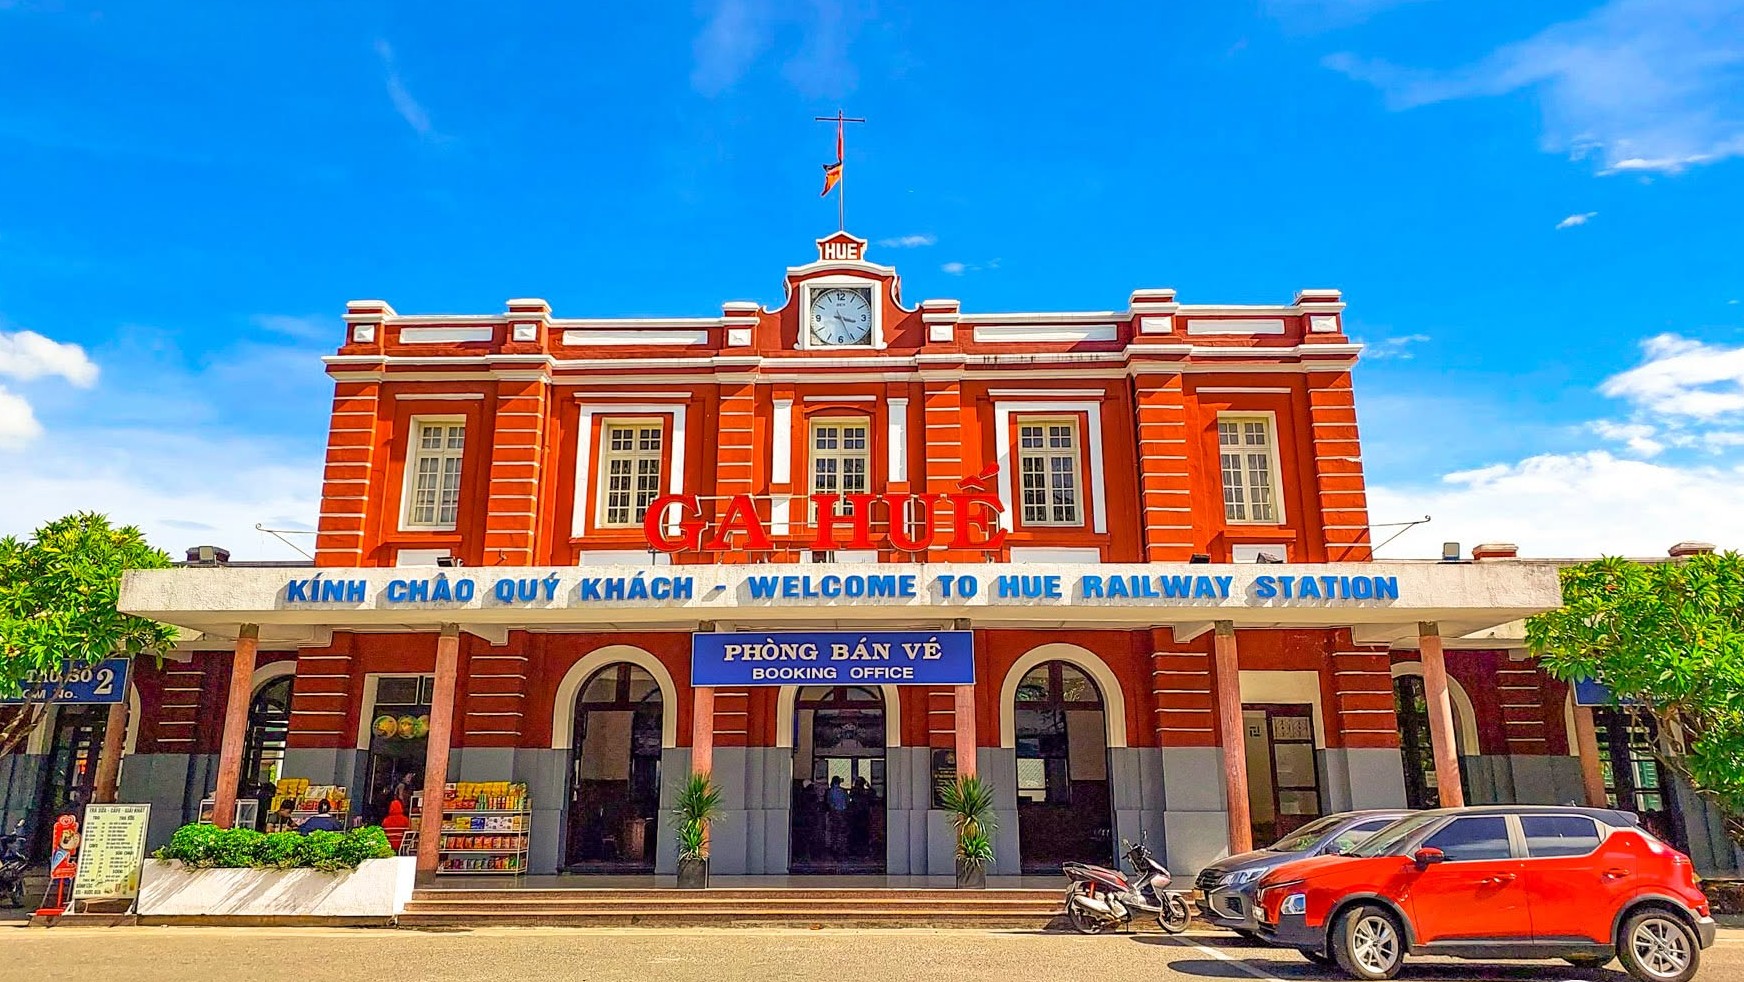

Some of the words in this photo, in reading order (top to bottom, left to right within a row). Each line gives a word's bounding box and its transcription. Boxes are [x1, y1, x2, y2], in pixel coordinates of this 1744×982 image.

[824, 242, 858, 260] HUE
[836, 292, 846, 301] 12
[815, 314, 822, 322] 9
[860, 315, 867, 323] 3
[837, 335, 845, 344] 6
[644, 494, 774, 551] GA
[810, 462, 1006, 550] HUẾ
[286, 573, 367, 602] KÍNH
[386, 573, 475, 602] CHÀO
[495, 572, 560, 603] QUÝ
[580, 571, 694, 601] KHÁCH
[748, 575, 916, 598] WELCOME
[937, 575, 979, 598] TO
[998, 575, 1062, 598] HUE
[1082, 575, 1234, 599] RAILWAY
[1255, 576, 1400, 600] STATION
[723, 638, 819, 661] PHÒNG
[830, 637, 891, 661] BÁN
[901, 636, 943, 660] VÉ
[752, 667, 838, 680] BOOKING
[849, 666, 915, 679] OFFICE
[93, 668, 115, 695] 2
